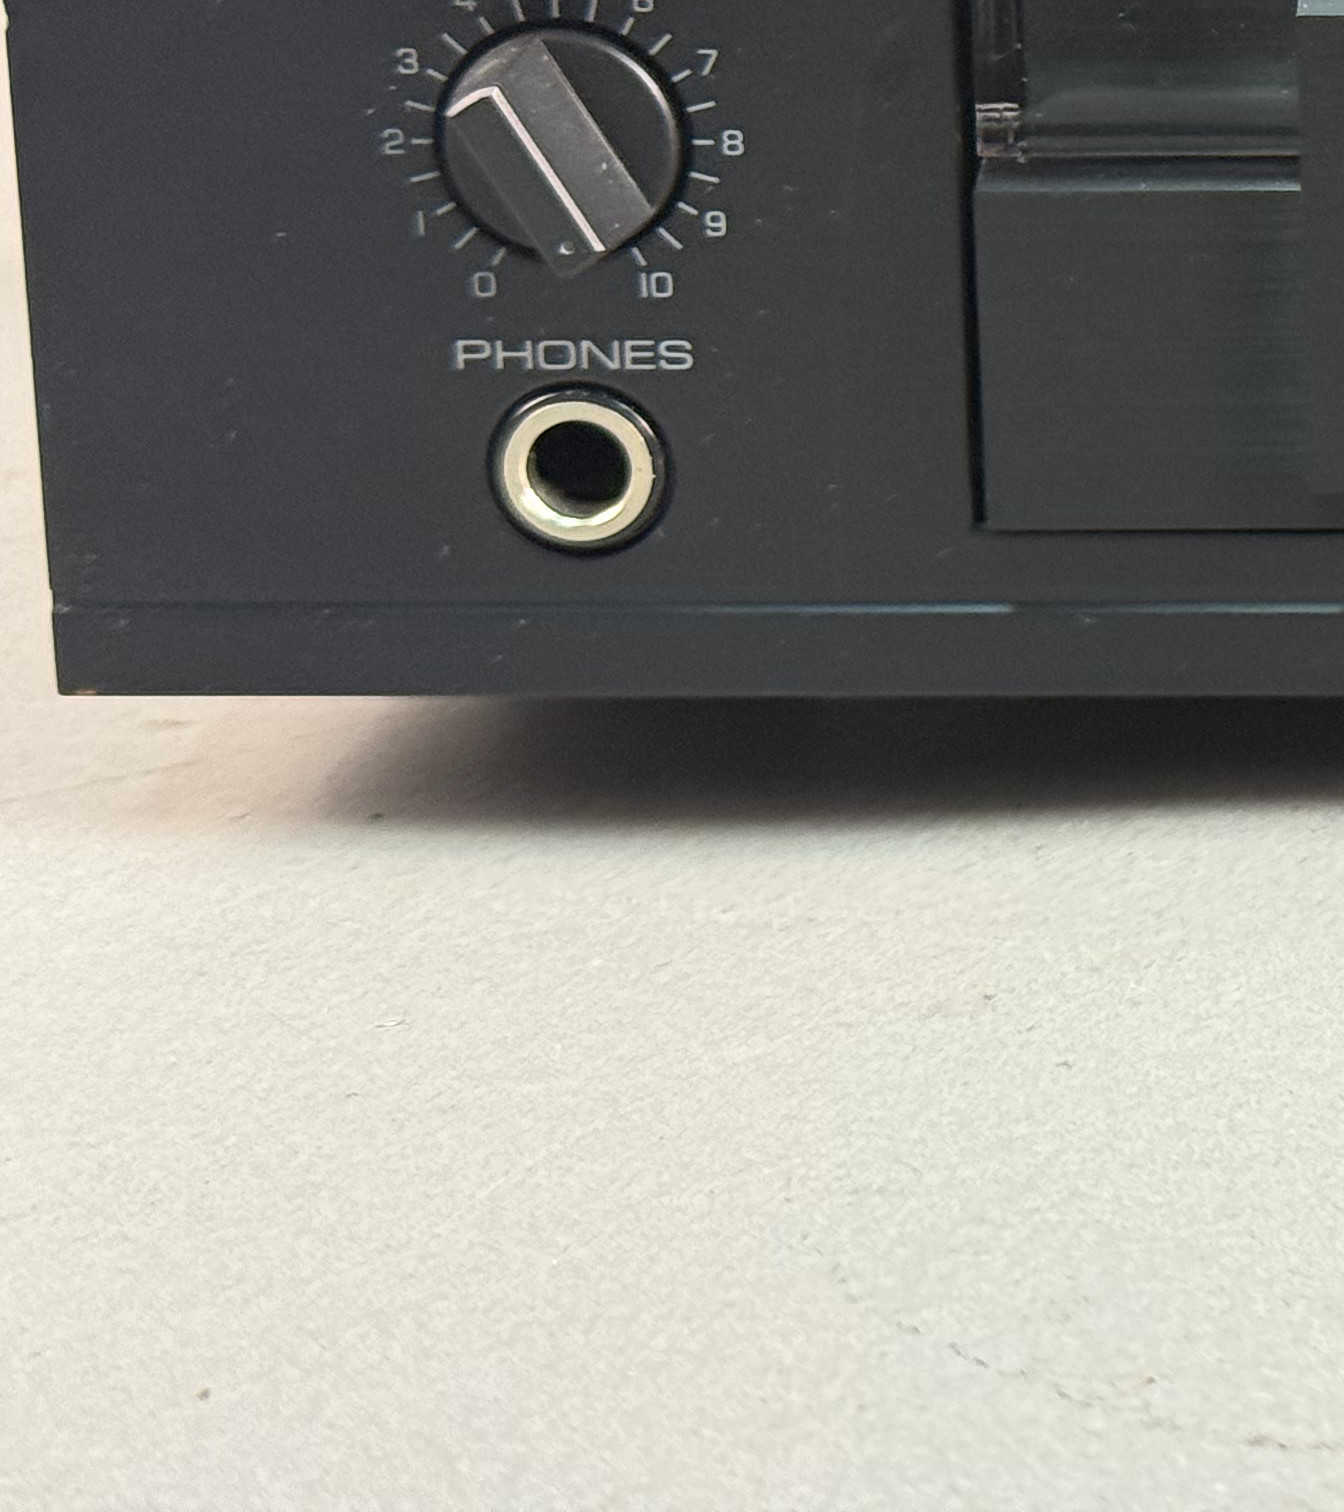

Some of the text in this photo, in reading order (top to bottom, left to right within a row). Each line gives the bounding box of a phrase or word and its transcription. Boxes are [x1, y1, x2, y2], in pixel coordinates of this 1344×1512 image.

[395, 47, 419, 75] 3
[696, 48, 719, 76] 7
[379, 128, 406, 155] 2
[721, 129, 745, 156] 8
[704, 210, 727, 237] 9
[470, 271, 497, 298] 0
[639, 271, 674, 298] 10
[454, 339, 694, 371] PHONES
